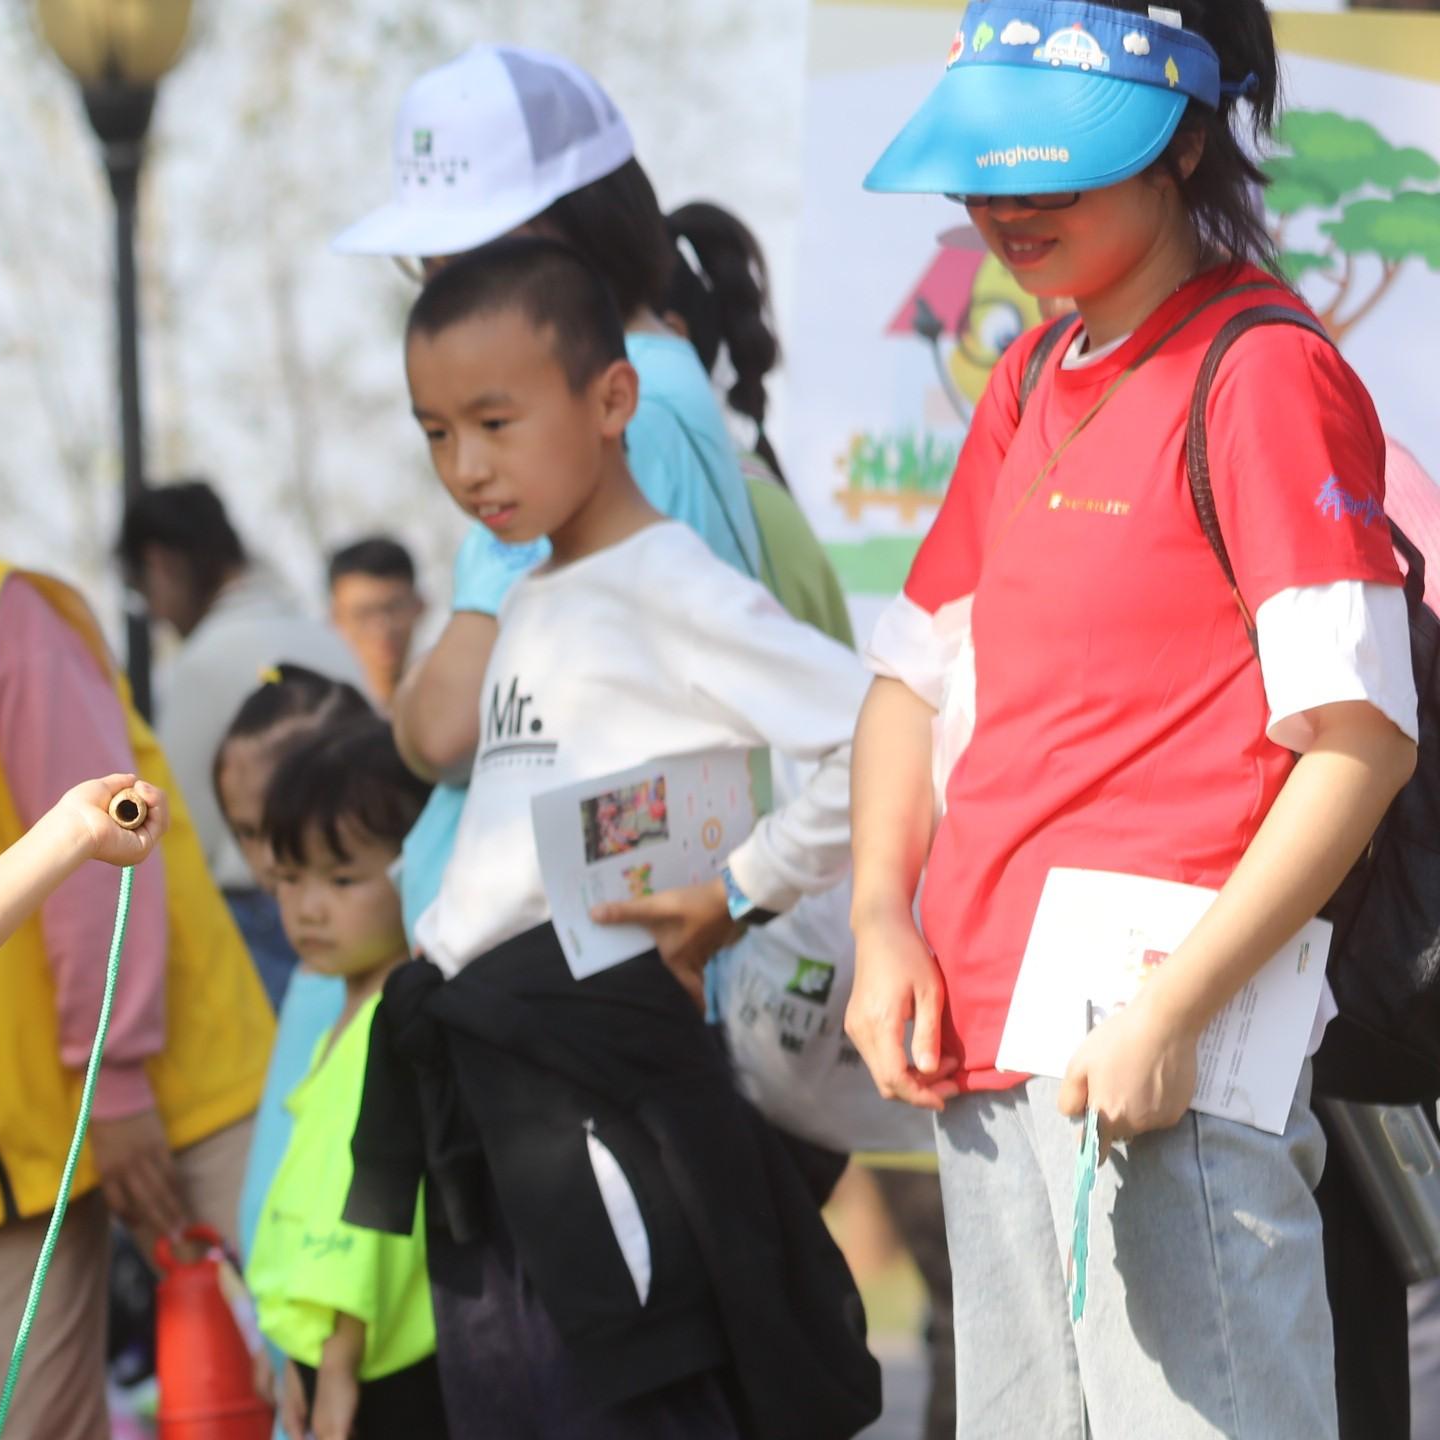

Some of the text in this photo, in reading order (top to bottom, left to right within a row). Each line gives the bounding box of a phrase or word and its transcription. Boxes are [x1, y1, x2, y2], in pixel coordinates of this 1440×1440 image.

[1051, 47, 1092, 60] POLICE
[975, 144, 1070, 169] winghouse
[487, 676, 543, 741] Mr.
